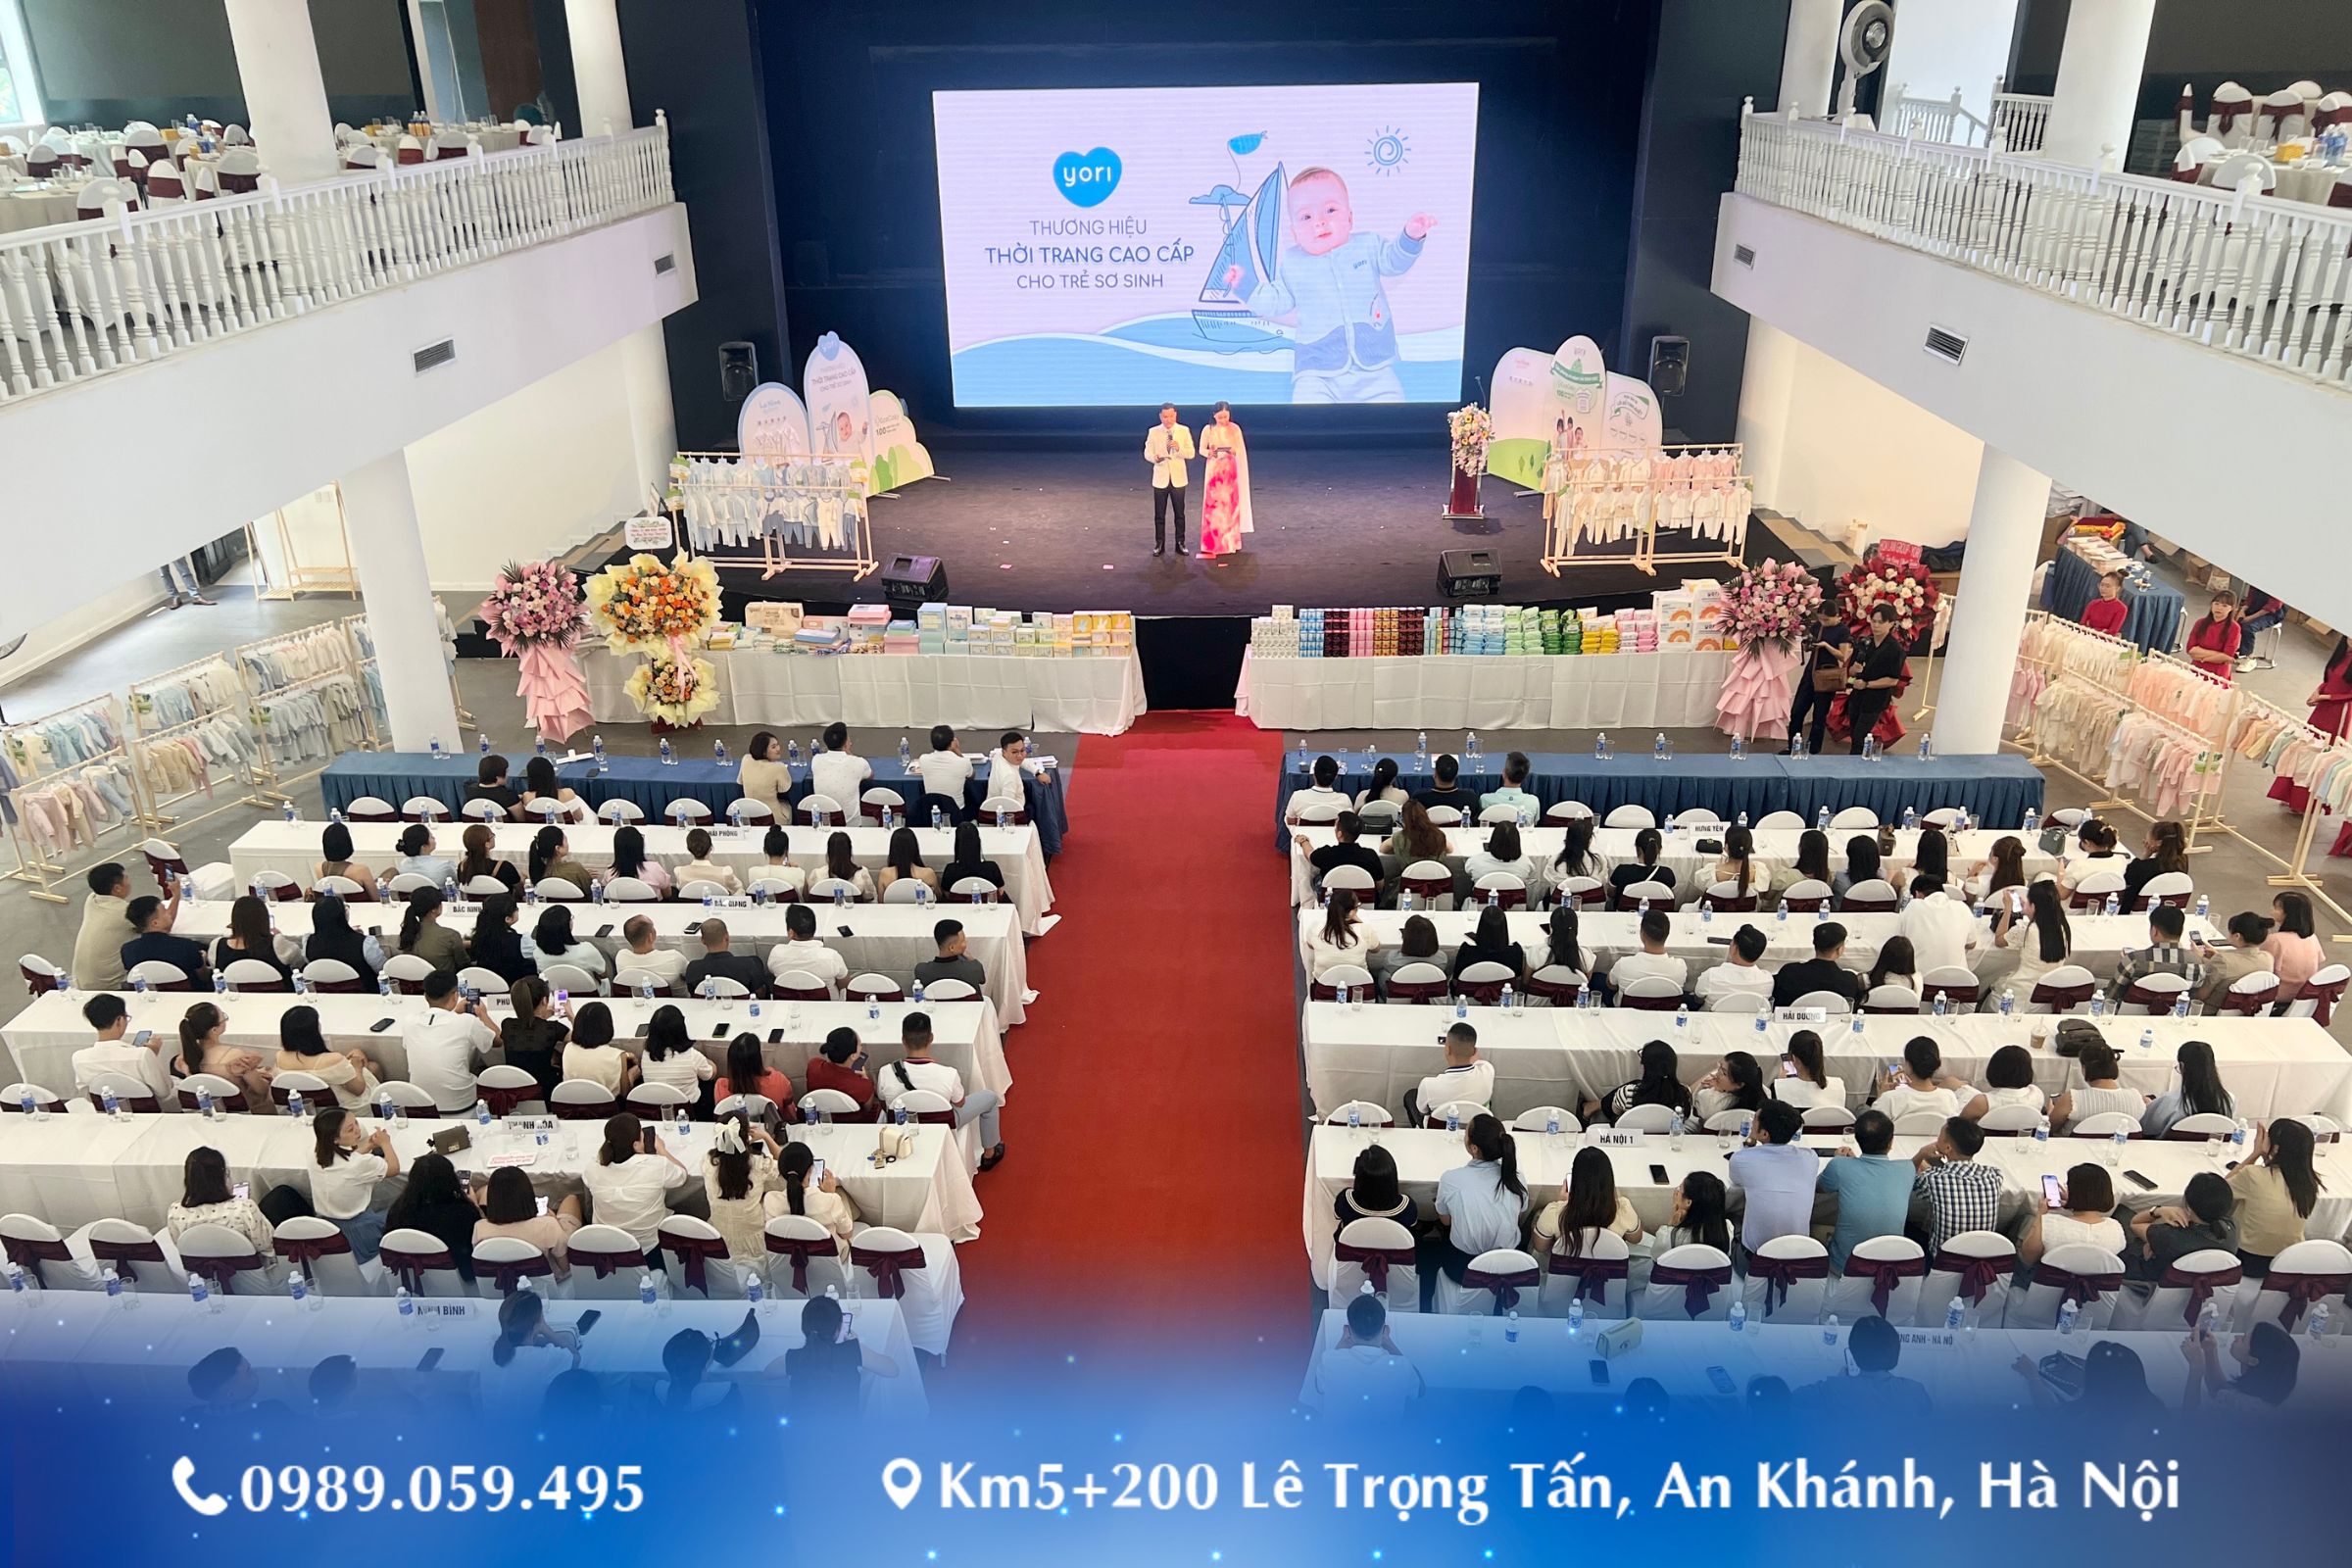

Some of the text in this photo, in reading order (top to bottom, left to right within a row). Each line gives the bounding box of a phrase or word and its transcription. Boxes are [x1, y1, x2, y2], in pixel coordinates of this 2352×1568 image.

[1063, 166, 1111, 188] yori
[1029, 216, 1147, 238] THƯƠNG HIỆU
[985, 237, 1195, 264] THỜI TRANG CAO CẤP
[1016, 270, 1163, 289] CHO TRẺ SƠ SINH
[1783, 1010, 1795, 1020] HẢI
[1599, 1133, 1634, 1145] HÀ NỘI 1
[443, 1304, 466, 1316] BÌNH
[1911, 1334, 1926, 1344] ANH
